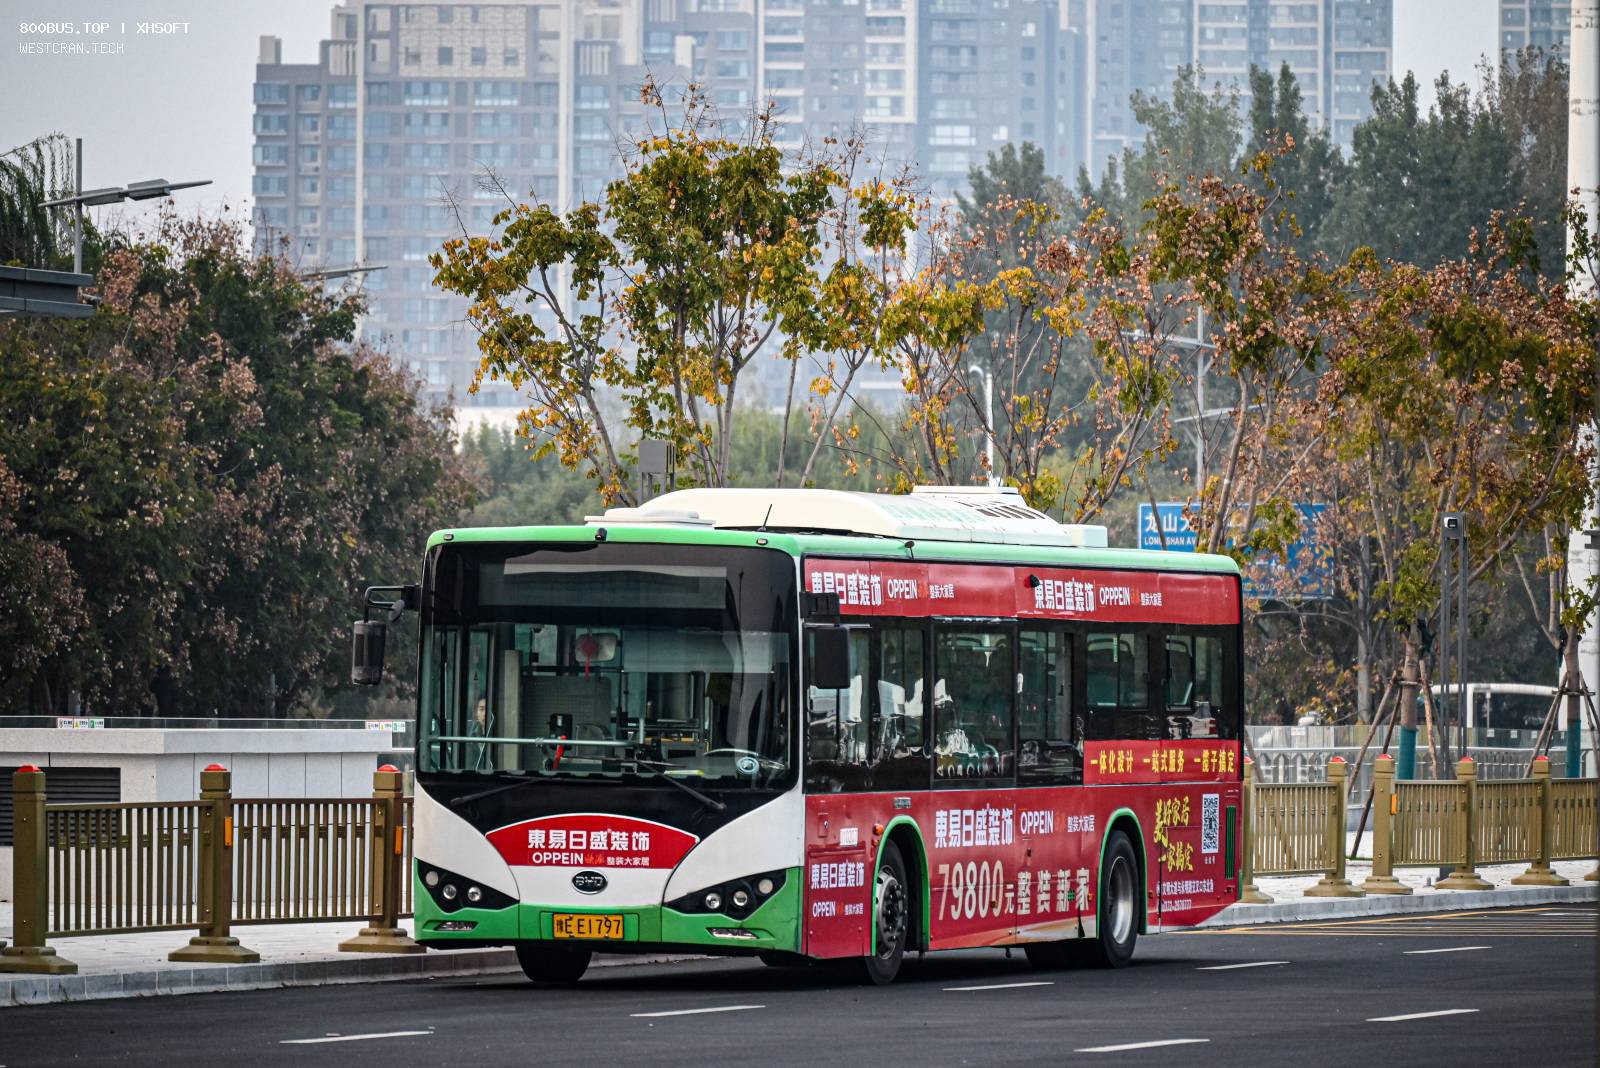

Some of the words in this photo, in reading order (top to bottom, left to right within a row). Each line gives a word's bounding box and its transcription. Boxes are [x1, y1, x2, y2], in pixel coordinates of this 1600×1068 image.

[887, 579, 918, 599] OPPEIN
[1090, 750, 1134, 774] 一体化设计
[1143, 749, 1185, 773] 一站式服务
[1020, 810, 1054, 834] OPPEIN
[532, 852, 584, 865] OPPEIN
[606, 856, 650, 867] 整装大家居
[812, 901, 836, 918] OPPEIN
